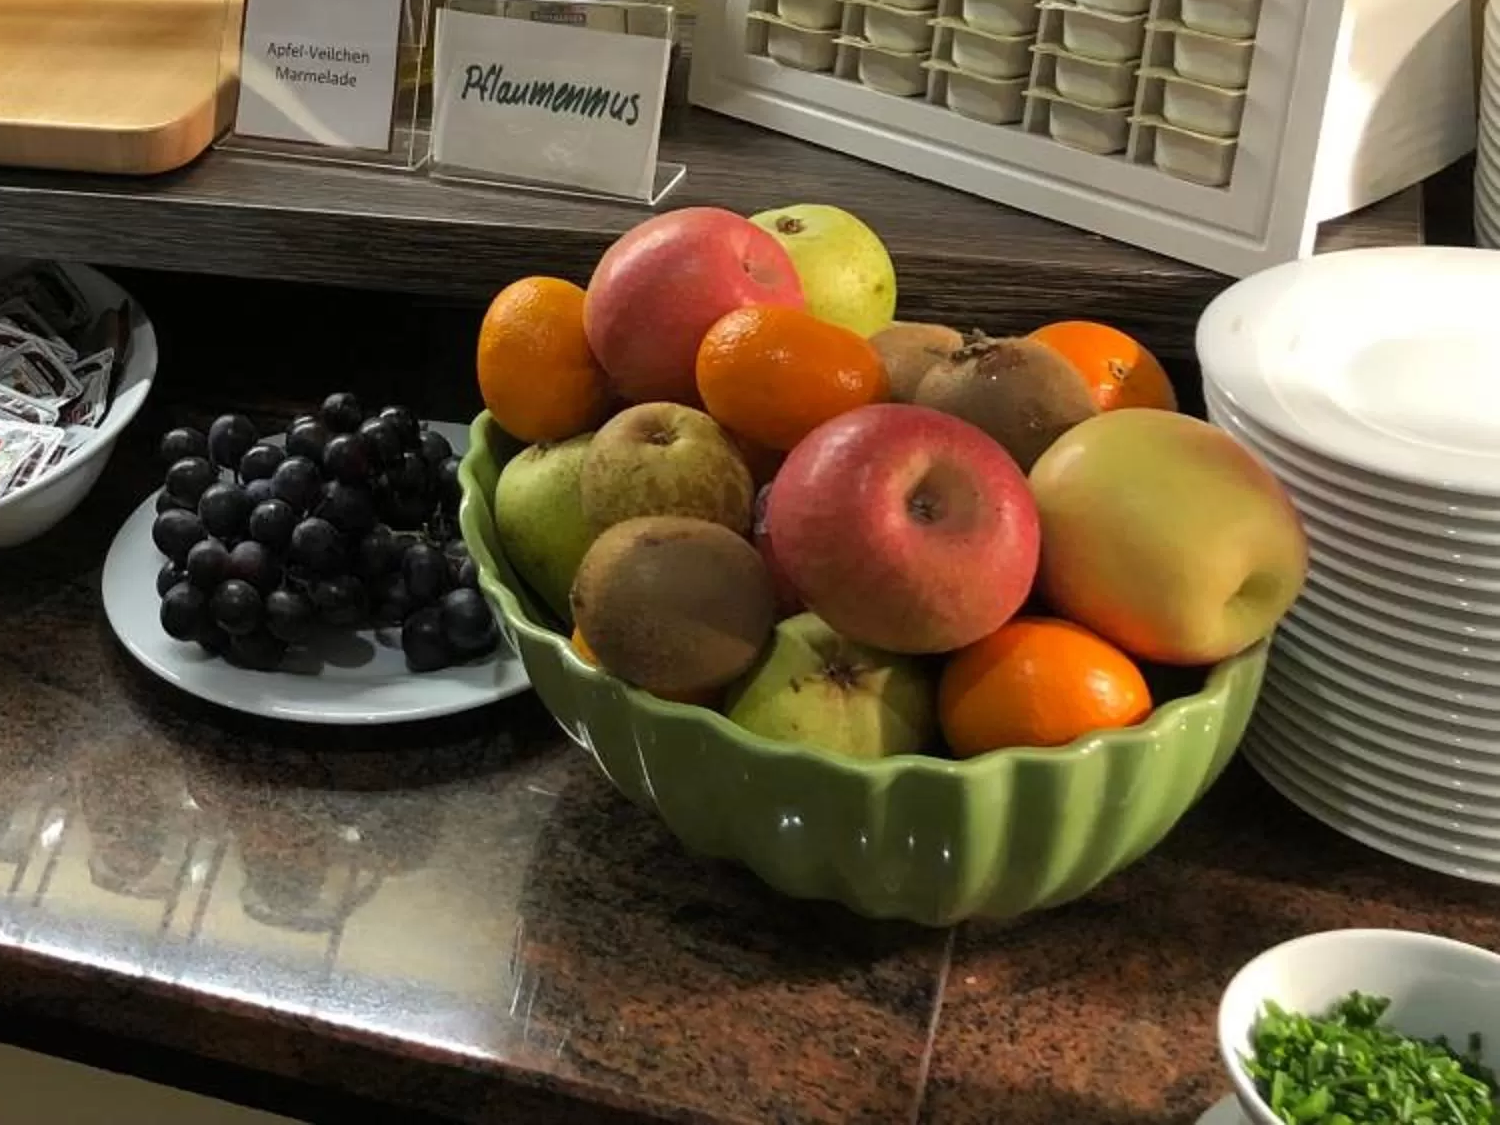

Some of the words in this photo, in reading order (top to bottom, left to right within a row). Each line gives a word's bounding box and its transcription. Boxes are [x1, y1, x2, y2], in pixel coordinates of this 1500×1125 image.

[267, 42, 370, 64] Apfel-Veilchen
[275, 66, 357, 87] Marmelade
[461, 63, 640, 126] Pflaumenmus
